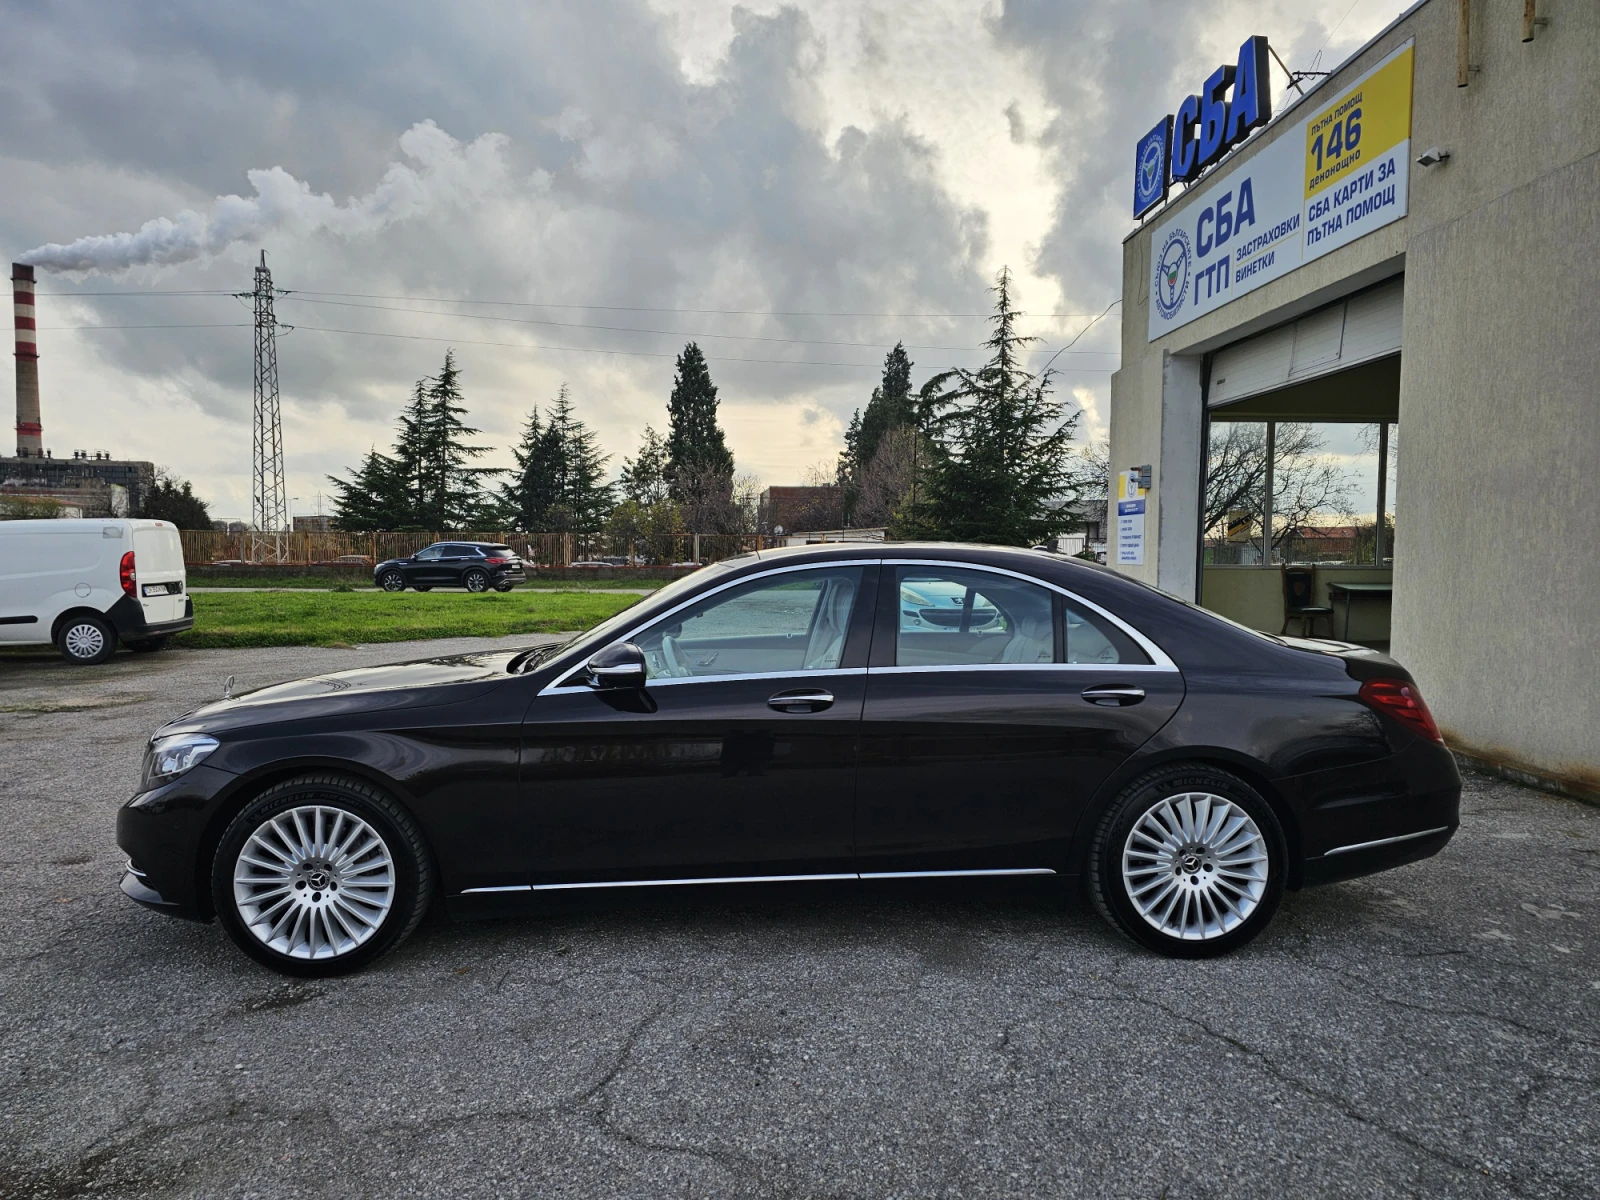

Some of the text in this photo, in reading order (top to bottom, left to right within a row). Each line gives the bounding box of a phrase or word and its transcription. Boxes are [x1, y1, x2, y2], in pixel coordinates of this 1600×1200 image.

[1172, 35, 1262, 176] СБА
[1311, 91, 1363, 136] ПЪТНА ПОМОЩ
[1311, 107, 1362, 172] 146
[1308, 157, 1396, 223] СБА КАРТИ ЗА
[1309, 149, 1361, 191] денонощно
[1196, 176, 1256, 259] СБА
[1236, 213, 1300, 262] ЗАСТРАХОВКИ
[1307, 183, 1396, 246] ПЪТНА ПОМОЩ
[1194, 254, 1230, 306] ГТП
[1236, 251, 1275, 284] ВИНЕТКИ
[261, 792, 315, 815] MICHELIN
[1172, 777, 1230, 791] MICHELIN
